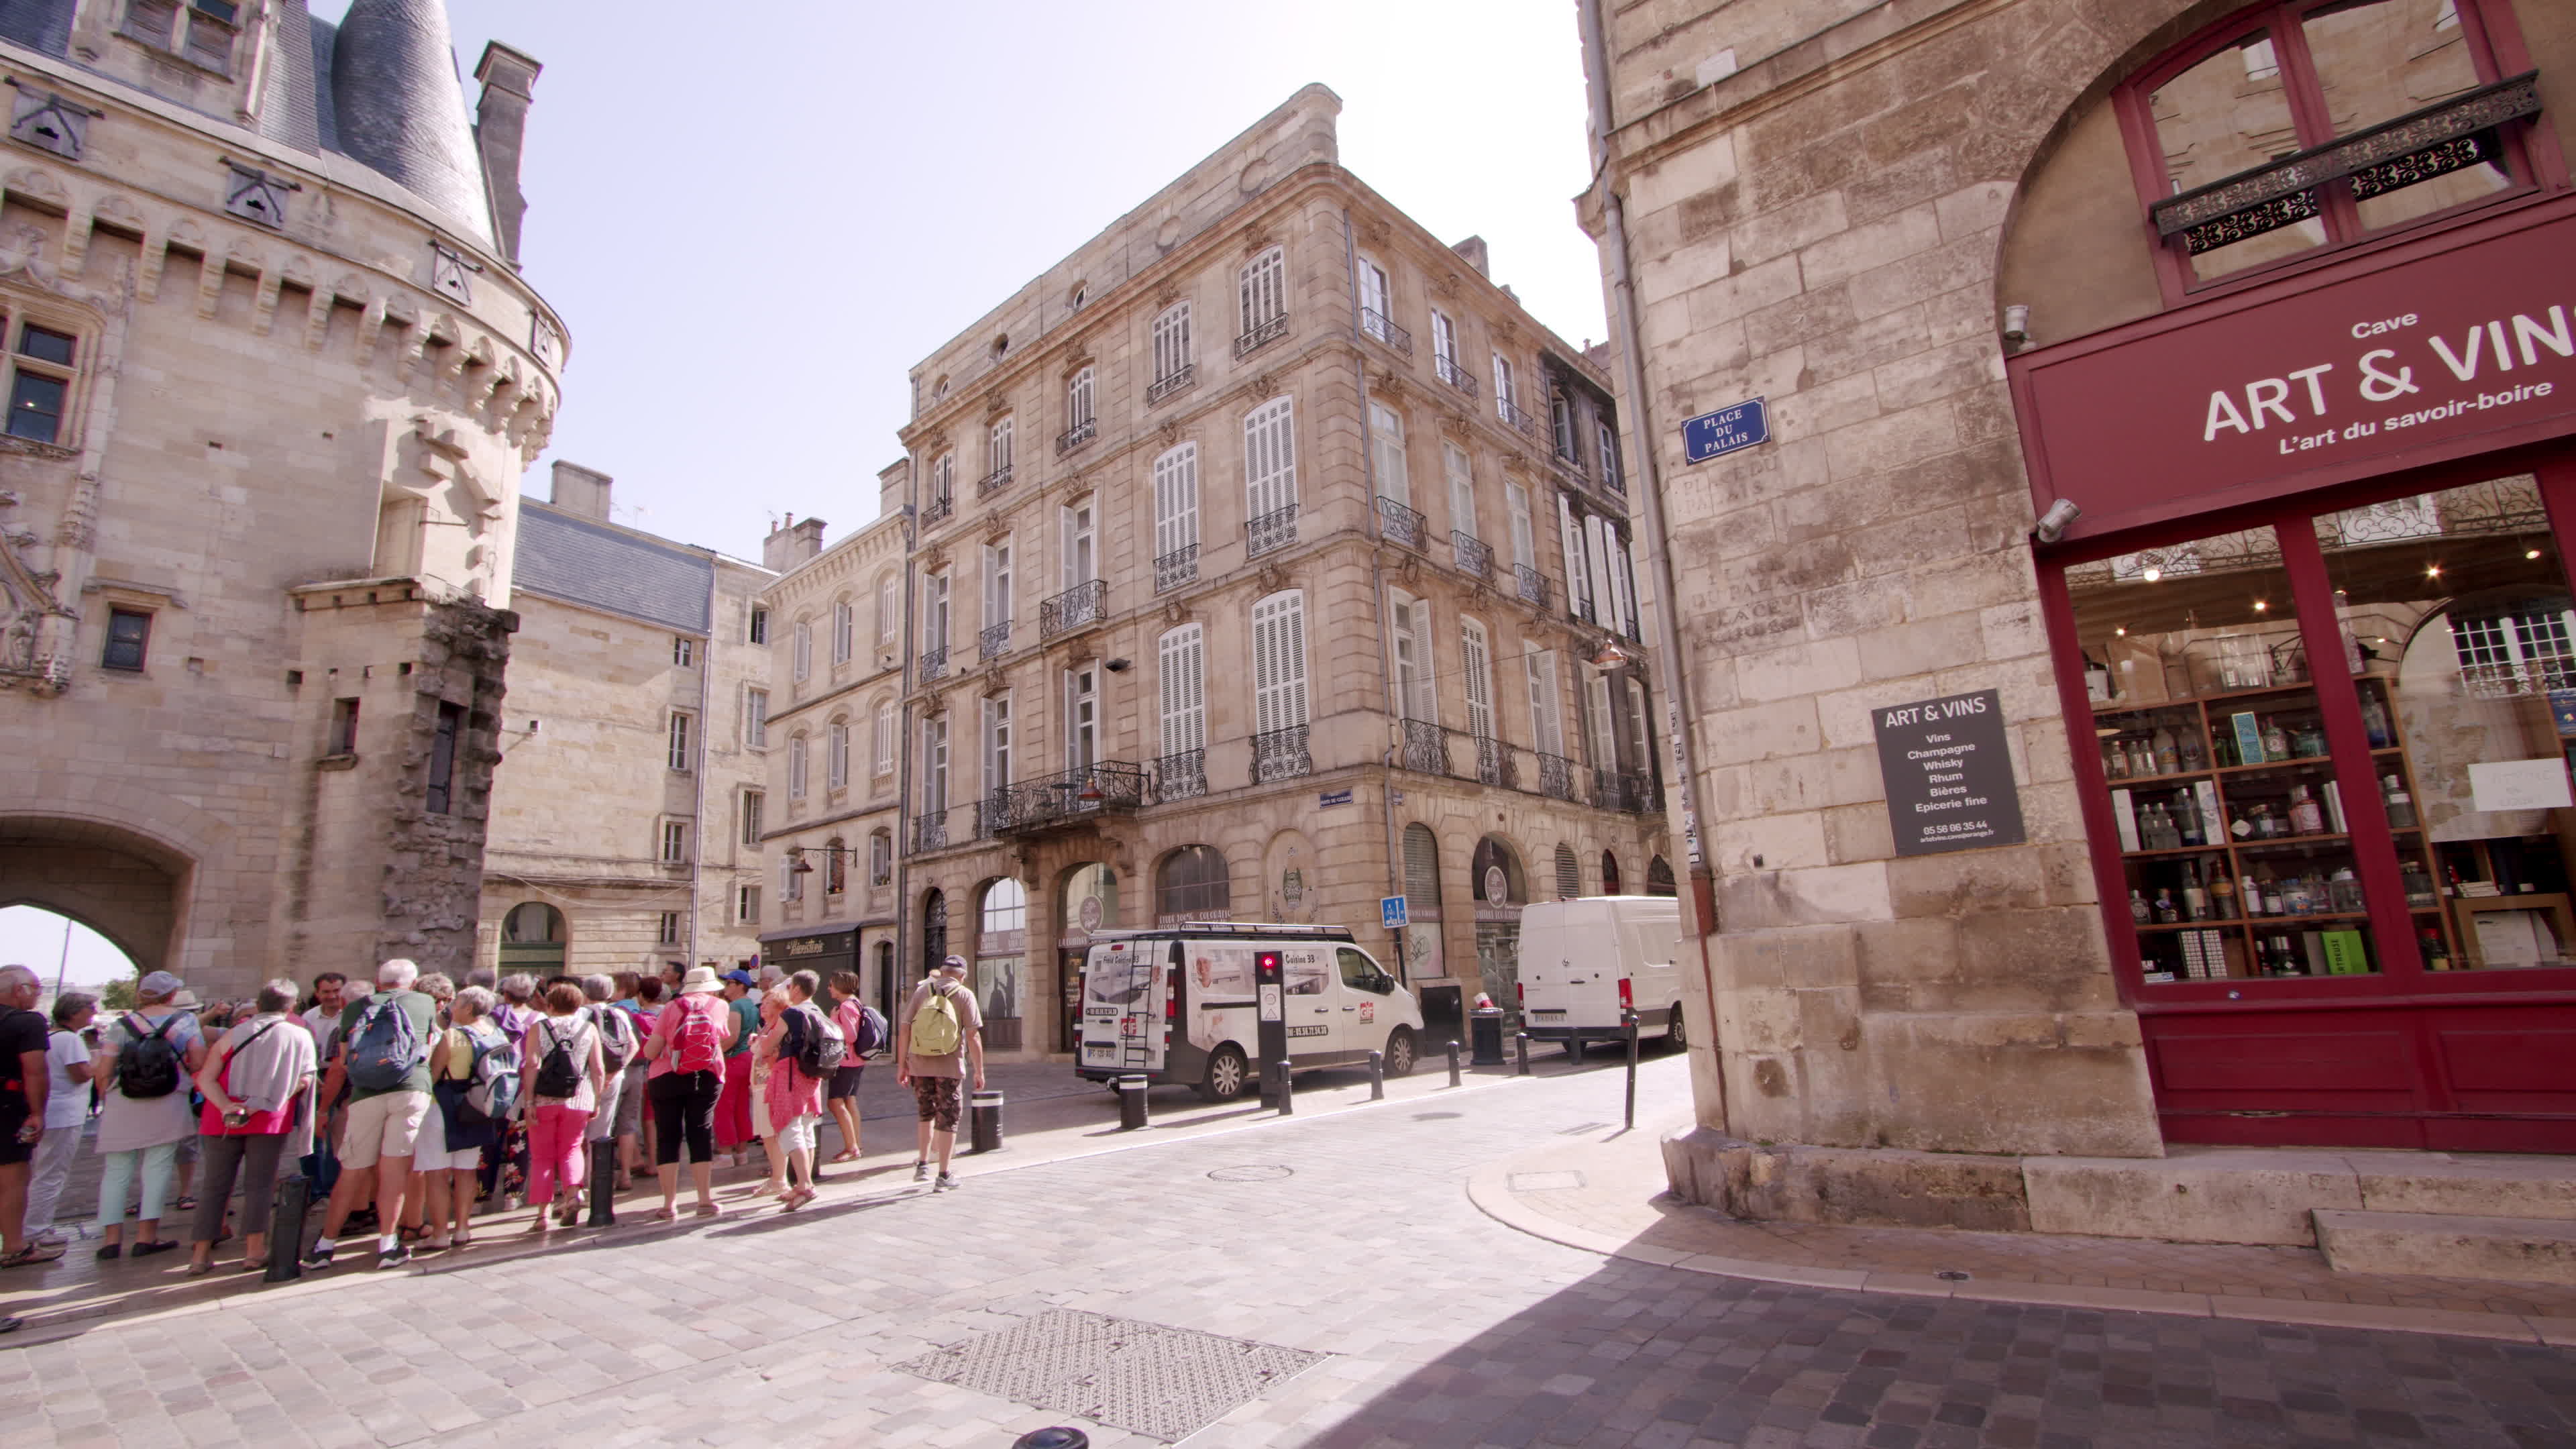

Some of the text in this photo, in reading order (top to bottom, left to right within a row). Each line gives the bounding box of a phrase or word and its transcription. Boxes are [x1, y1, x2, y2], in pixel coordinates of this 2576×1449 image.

[2351, 313, 2418, 338] Cave
[2204, 305, 2576, 441] ART & VIN
[1703, 409, 1743, 429] PLACE
[2280, 382, 2553, 454] L'art du savoir-boire
[1715, 425, 1733, 437] DU
[1705, 432, 1748, 453] PALAIS
[1885, 697, 1986, 728] ART & VINS
[1926, 733, 1951, 743] Vins
[1907, 743, 1976, 760] Champagne
[1923, 759, 1964, 771] Whisky
[1929, 773, 1964, 784] Rhum
[1930, 786, 1968, 797] Bières
[1915, 796, 1988, 814] Epicerie fine
[1923, 826, 1935, 835] 05
[1937, 824, 1948, 834] 56
[1963, 821, 1975, 831] 35
[1976, 820, 1988, 829] 44
[1285, 954, 1315, 964] Cuisine 33
